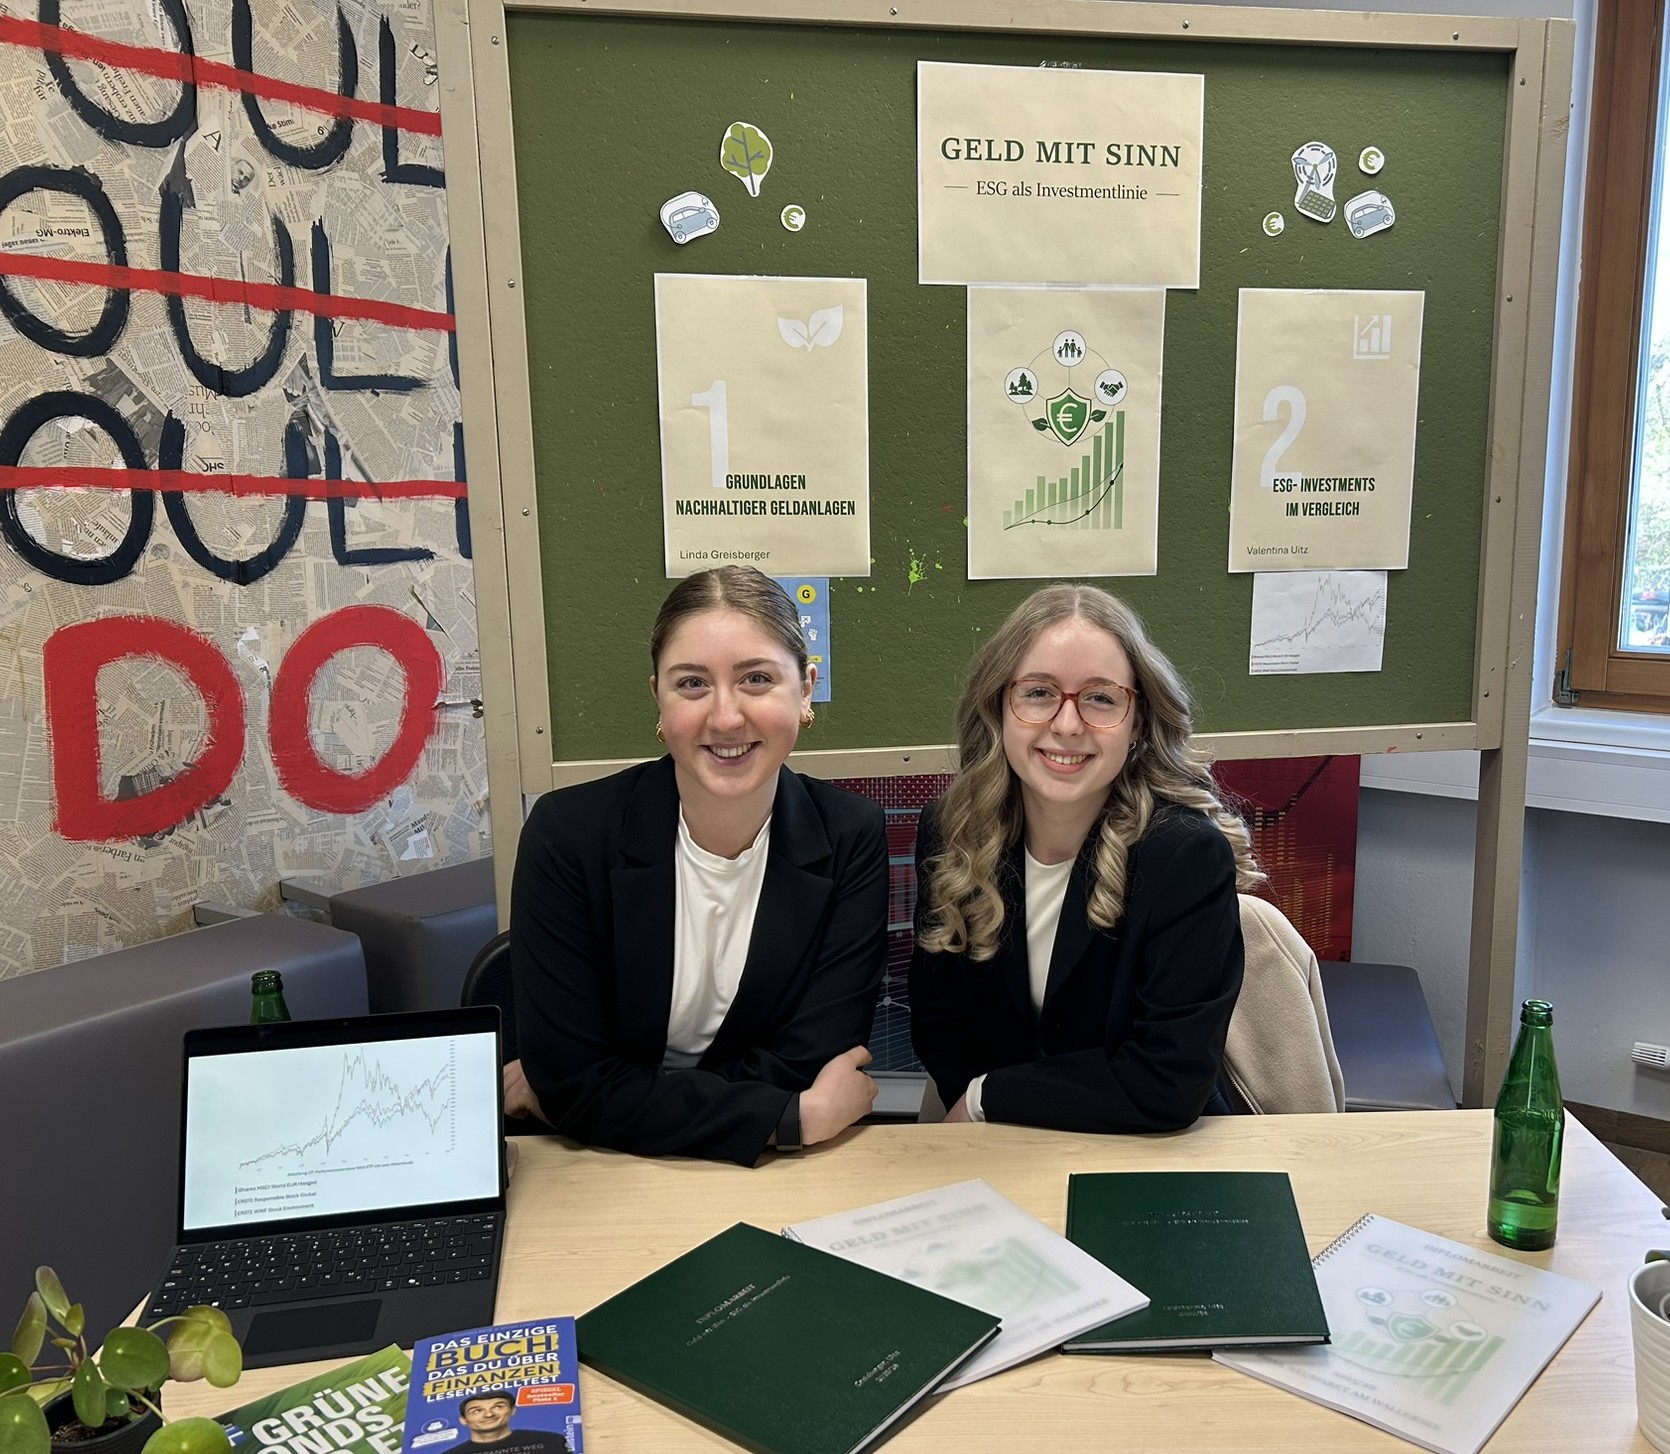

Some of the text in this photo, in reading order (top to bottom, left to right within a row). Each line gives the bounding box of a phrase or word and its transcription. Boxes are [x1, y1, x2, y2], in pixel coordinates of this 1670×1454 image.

[941, 137, 1181, 168] GELD MIT SINN
[976, 180, 1148, 200] ESG als Investmentlinie
[691, 380, 730, 488] 1
[1260, 385, 1307, 488] 2
[725, 474, 806, 490] GRUNDLAGEN
[1273, 477, 1376, 493] ESG- INVESTMENTS
[675, 500, 856, 516] NACHHALTIGER GELDANLAGEN
[1286, 502, 1360, 517] IM VERGLEICH
[680, 550, 770, 562] Linda Greisberger
[1247, 546, 1308, 555] Valentina Uitz
[802, 590, 810, 599] G
[43, 604, 448, 842] DO
[1424, 1244, 1526, 1280] DIPLOMARBEIT
[1366, 1244, 1427, 1270] GELD
[1433, 1267, 1483, 1288] MIT
[1486, 1285, 1551, 1312] SINN
[431, 1336, 471, 1352] DAS
[478, 1325, 557, 1344] EINZIGE
[435, 1335, 551, 1368] BUCH
[428, 1352, 558, 1381] DAS DU ÜBER
[432, 1364, 553, 1392] FINANZEN
[426, 1375, 558, 1403] LESEN SOLLTEST
[252, 1366, 410, 1446] GRÜNE
